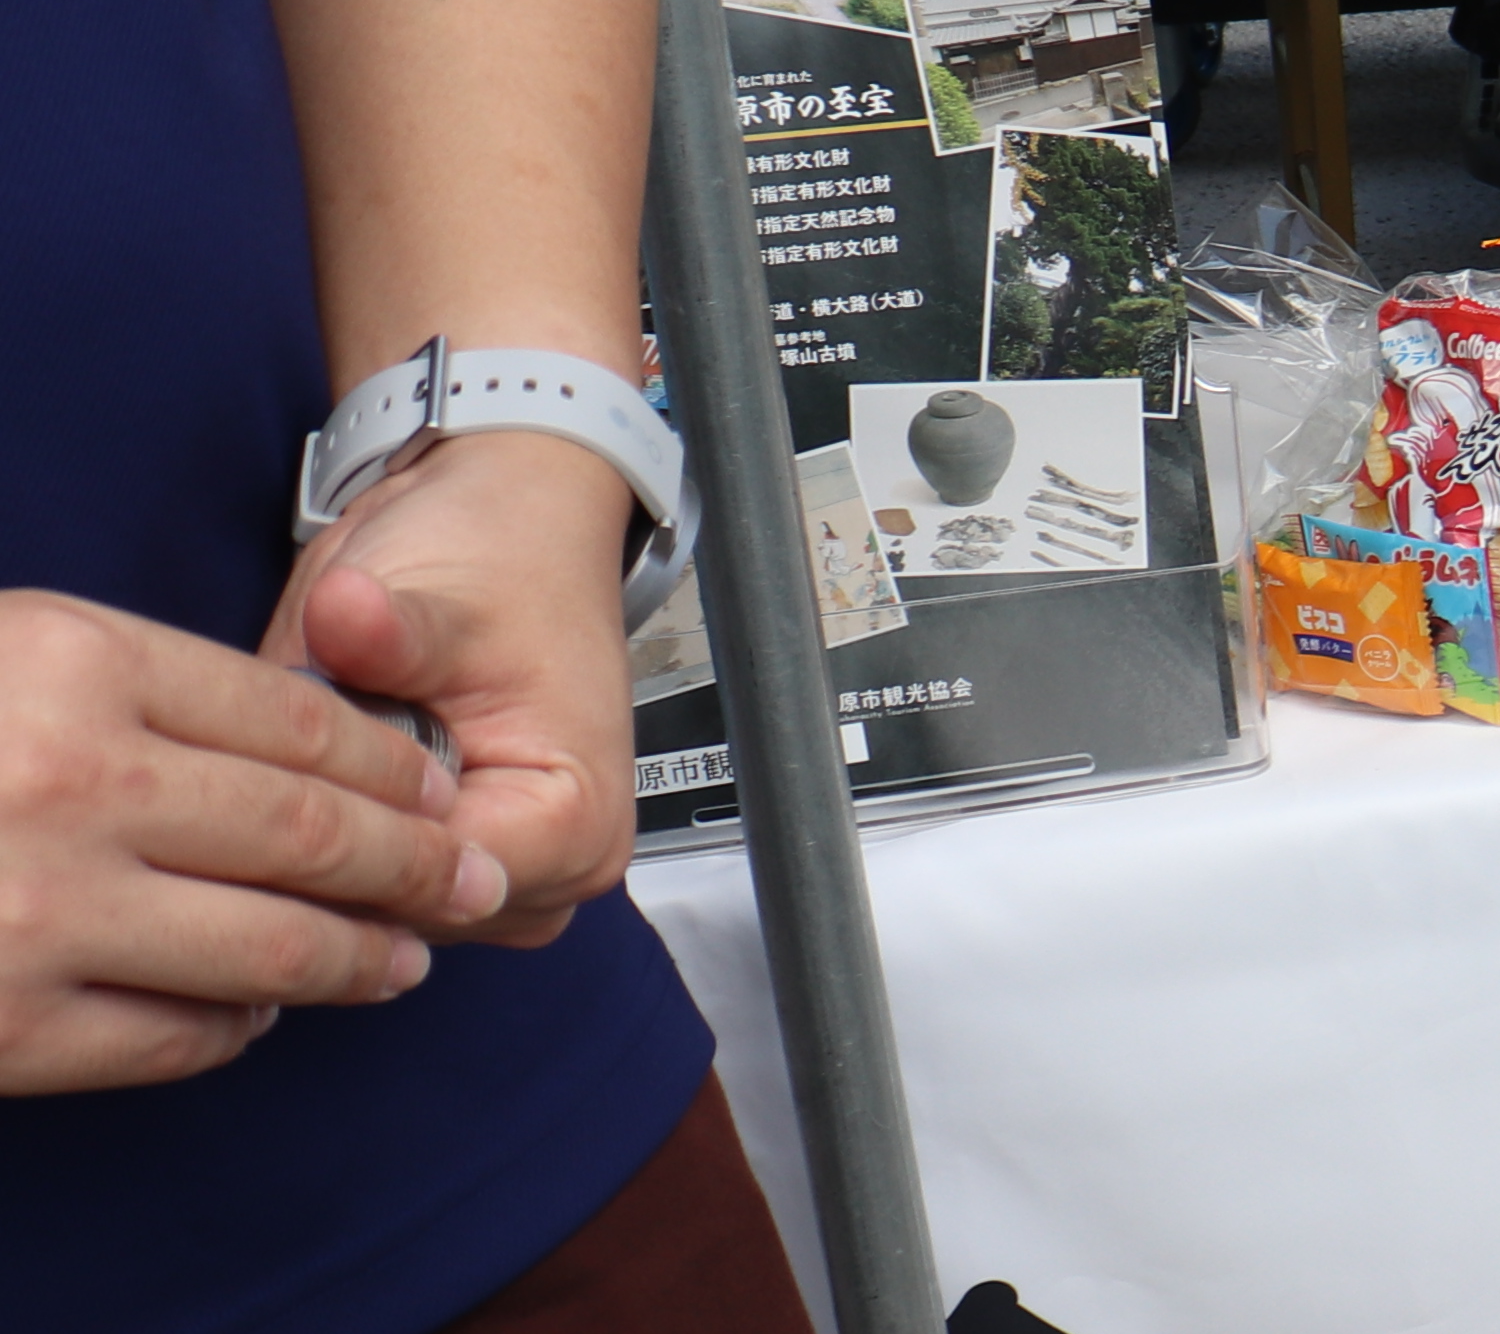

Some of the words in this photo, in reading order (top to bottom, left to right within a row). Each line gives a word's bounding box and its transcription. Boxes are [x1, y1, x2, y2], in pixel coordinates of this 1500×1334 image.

[735, 70, 813, 89] 化に育まれた
[769, 288, 924, 322] 道・横大路(大道)
[780, 343, 858, 367] 塚山古墳
[1297, 604, 1346, 635] ビスコ
[1364, 649, 1392, 660] バニラ
[838, 677, 973, 714] 原市観光協会
